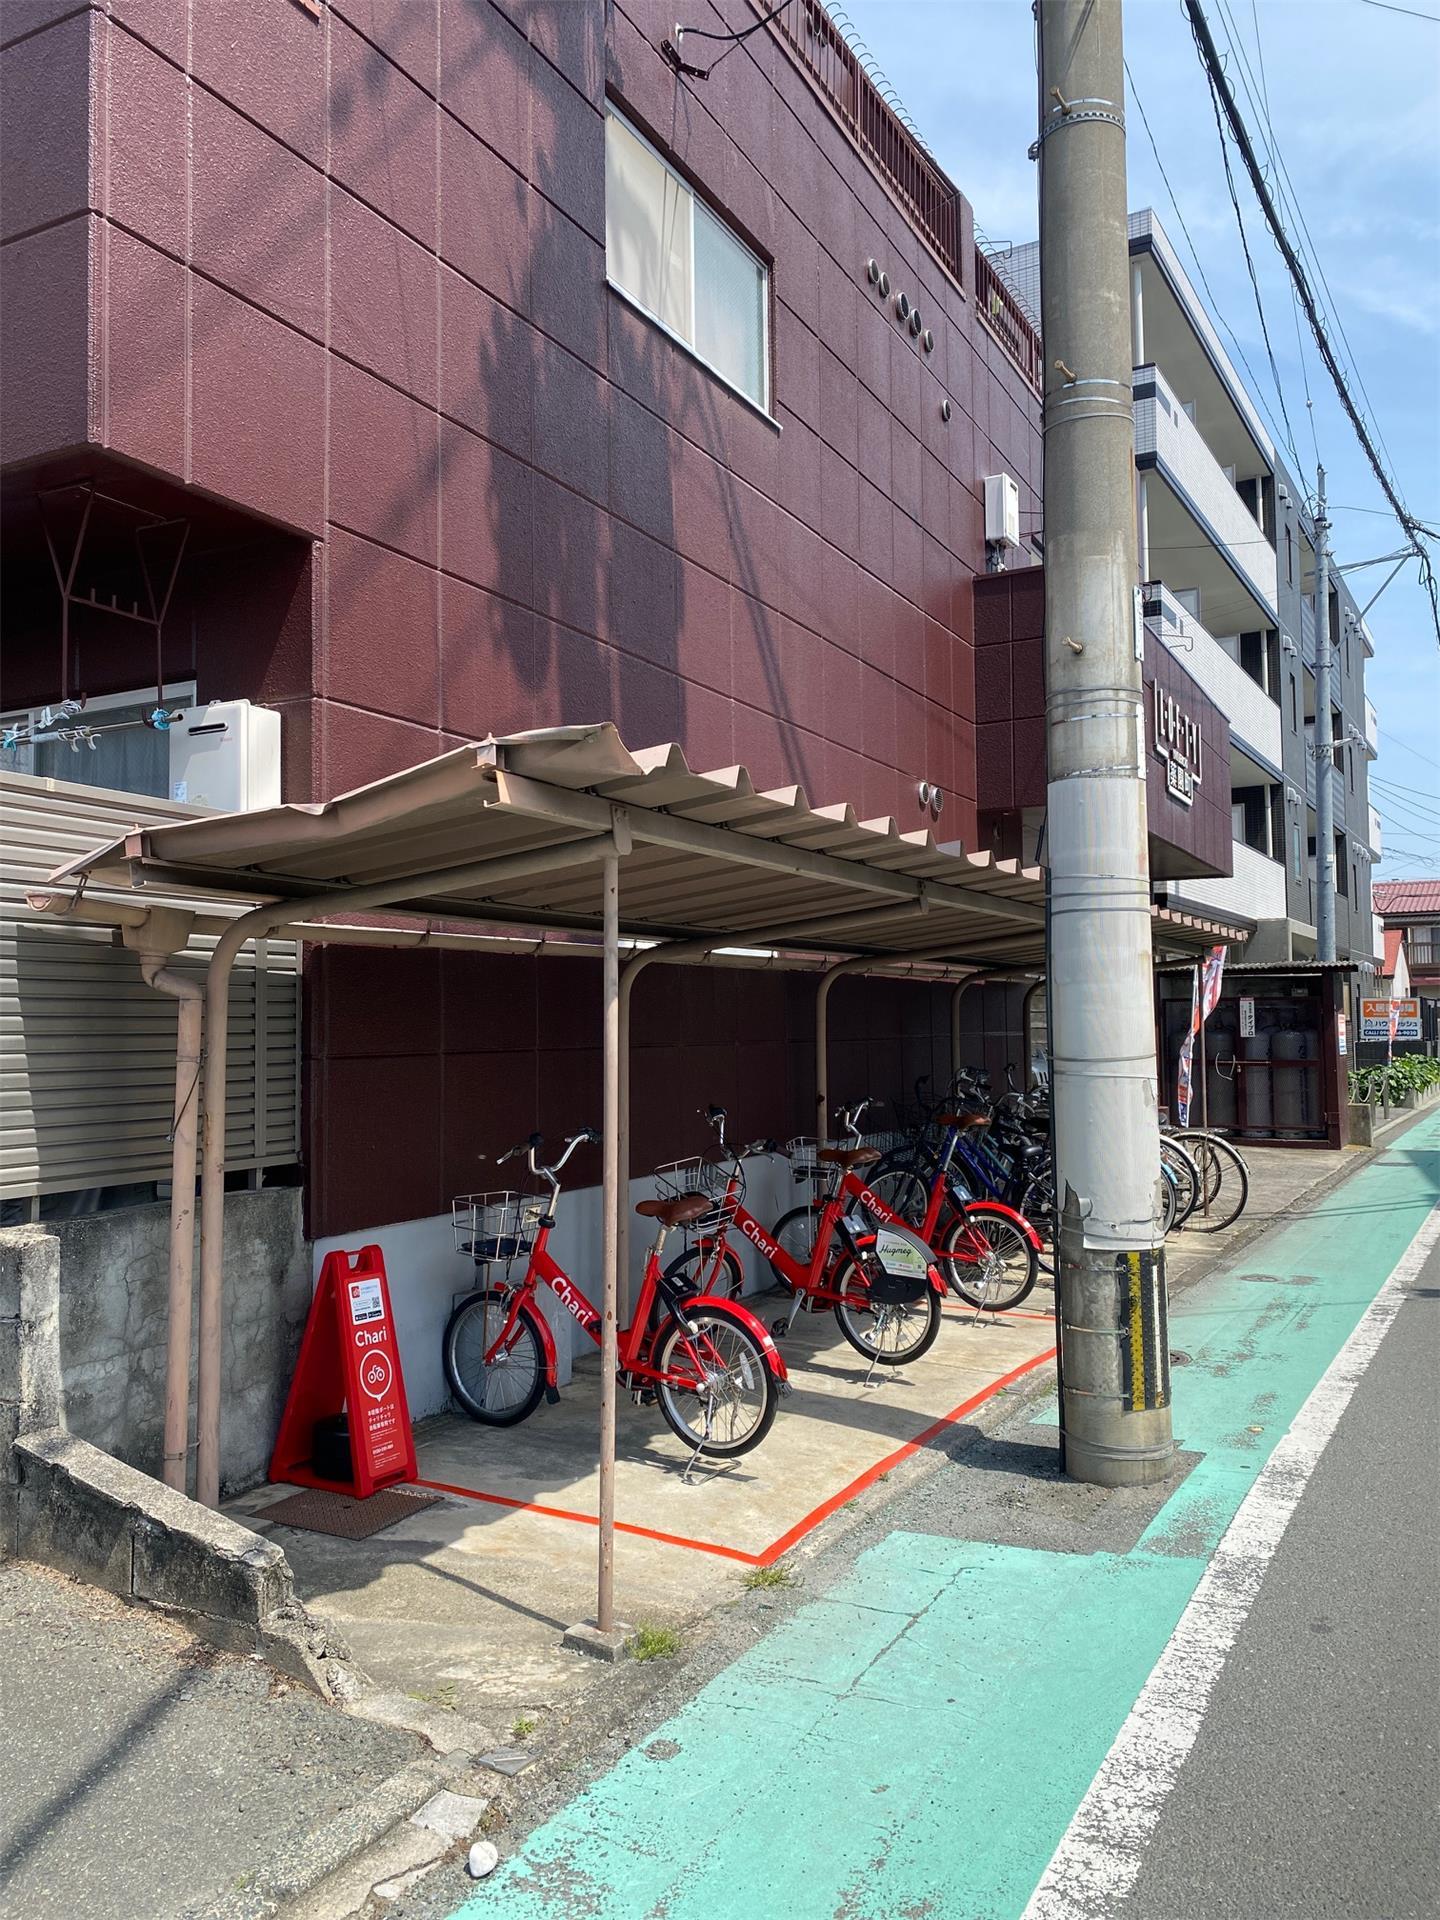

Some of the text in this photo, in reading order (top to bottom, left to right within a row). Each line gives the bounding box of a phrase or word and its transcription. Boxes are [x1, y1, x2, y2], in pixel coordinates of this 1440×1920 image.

[860, 1190, 893, 1224] Chari
[742, 1220, 778, 1260] Chari
[551, 1277, 593, 1326] Chari
[355, 1326, 387, 1348] Chari
